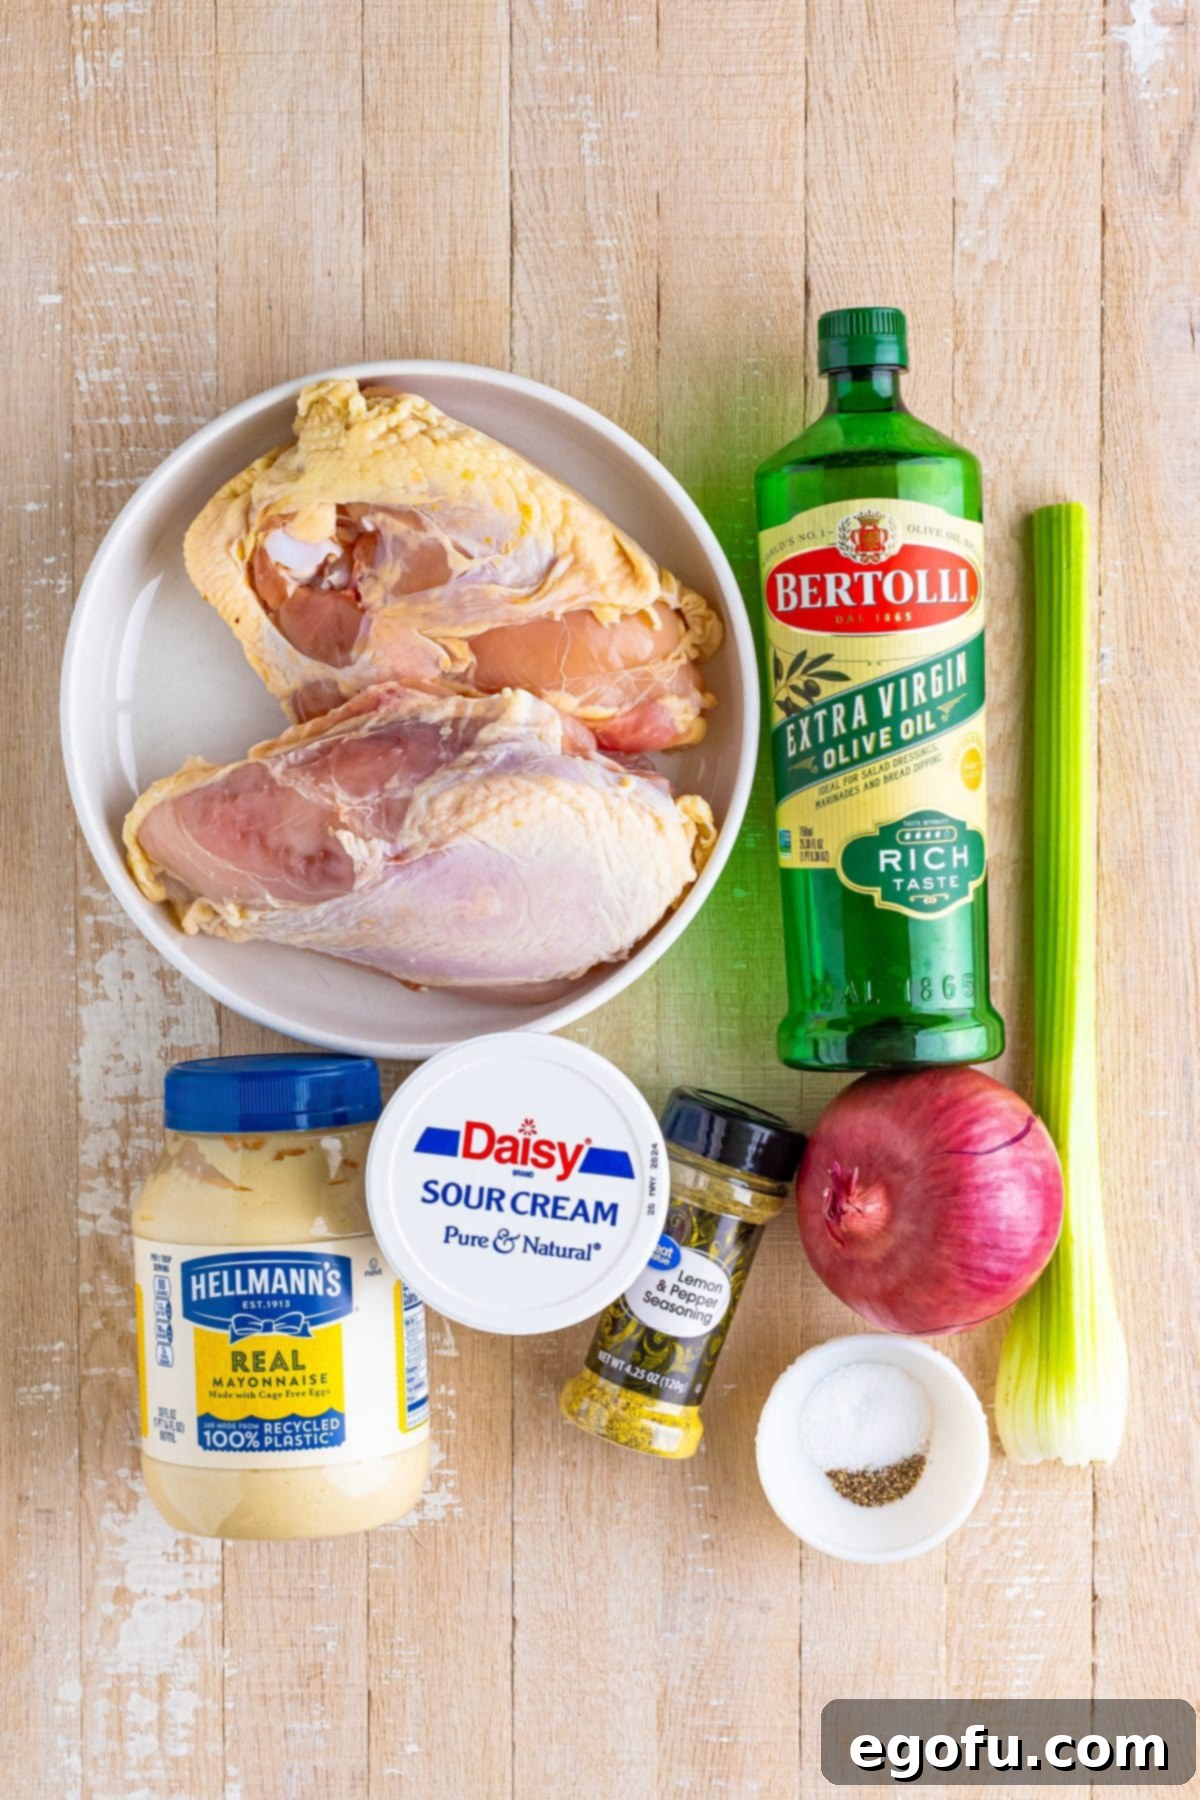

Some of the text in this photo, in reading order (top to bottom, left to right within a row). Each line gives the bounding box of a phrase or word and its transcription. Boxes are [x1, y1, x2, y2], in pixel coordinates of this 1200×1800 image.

[906, 524, 962, 544] OLIVE OIL
[775, 568, 969, 612] BERTOLLI
[875, 611, 912, 623] 1865
[786, 651, 967, 758] EXTRA VIRGIN
[823, 710, 936, 769] OLIVE OIL
[815, 786, 860, 810] MARINADES
[863, 779, 880, 791] AND
[883, 766, 911, 784] BREAD
[913, 752, 944, 772] DIPPING
[818, 781, 840, 796] IDEAL
[843, 773, 858, 786] FOR
[861, 761, 890, 780] SALAD
[879, 845, 969, 872] RICH
[893, 875, 959, 891] TASTE
[461, 1120, 585, 1182] Daisy
[650, 1143, 659, 1169] 2024
[512, 1169, 535, 1178] BRAND
[421, 1179, 619, 1227] SOUR CREAM
[443, 1225, 489, 1249] Pure
[492, 1228, 520, 1254] &
[191, 1262, 341, 1302] HELLMANN'S
[656, 1279, 719, 1309] & Pepper
[678, 1270, 723, 1294] Lemon
[643, 1290, 713, 1326] Seasoning
[231, 1349, 306, 1373] REAL
[597, 1350, 611, 1364] NET
[611, 1358, 625, 1371] WT
[624, 1365, 646, 1380] 4.25
[646, 1371, 660, 1384] OZ
[208, 1388, 330, 1400] Made with Cage Free Eggs
[212, 1373, 328, 1388] MAYONNAISE
[203, 1431, 260, 1448] 100%
[264, 1418, 340, 1434] RECYCLED
